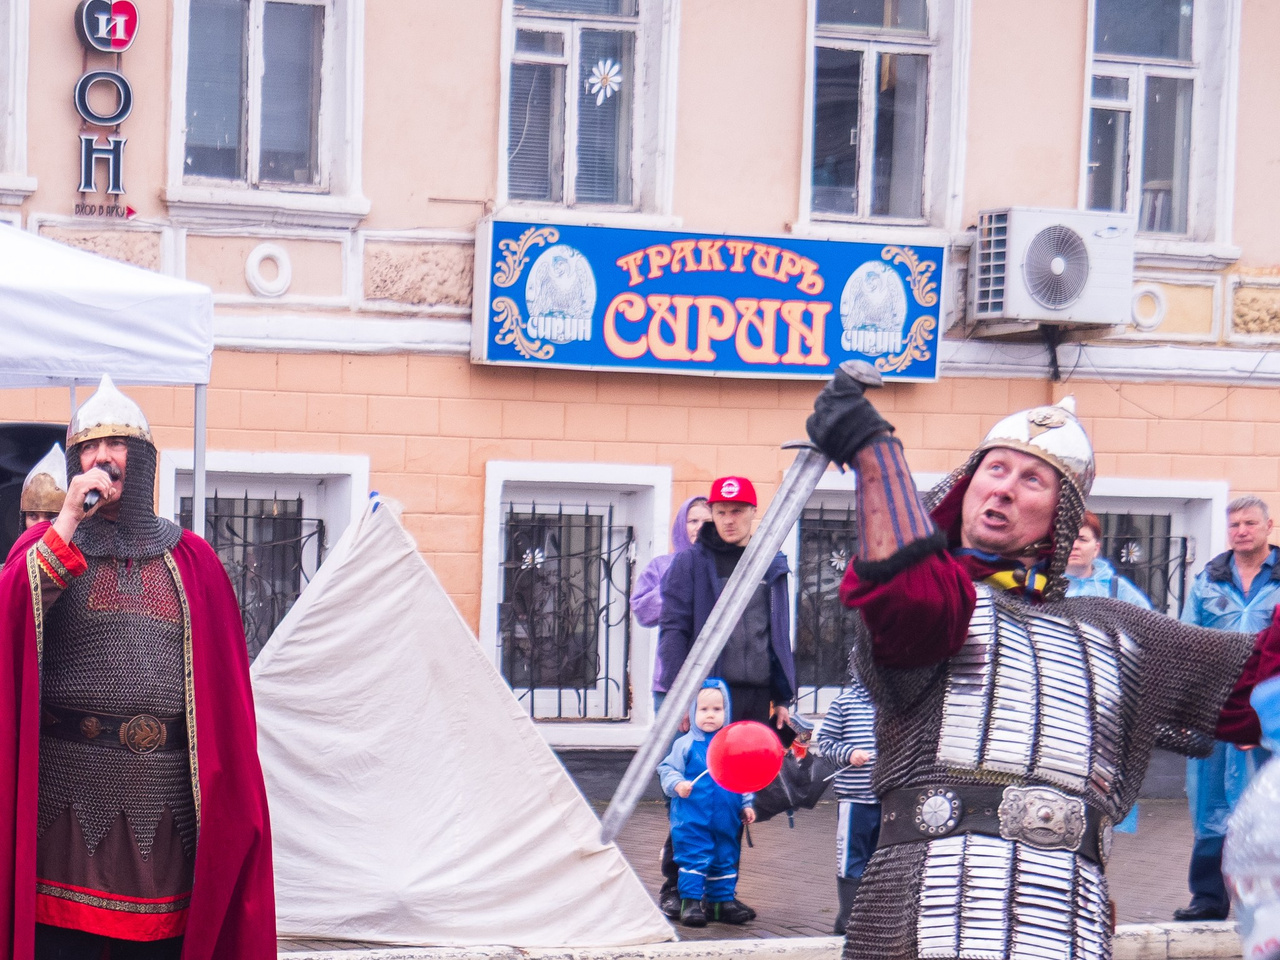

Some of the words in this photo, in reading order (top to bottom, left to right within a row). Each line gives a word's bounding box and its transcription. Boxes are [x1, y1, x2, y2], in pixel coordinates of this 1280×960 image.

[74, 203, 97, 216] ВХОД
[98, 205, 104, 216] В
[616, 239, 825, 295] ТРАКТИРЪ
[526, 316, 592, 341] СИРИН
[604, 292, 833, 366] СИРИН
[841, 329, 902, 353] СИРИН
